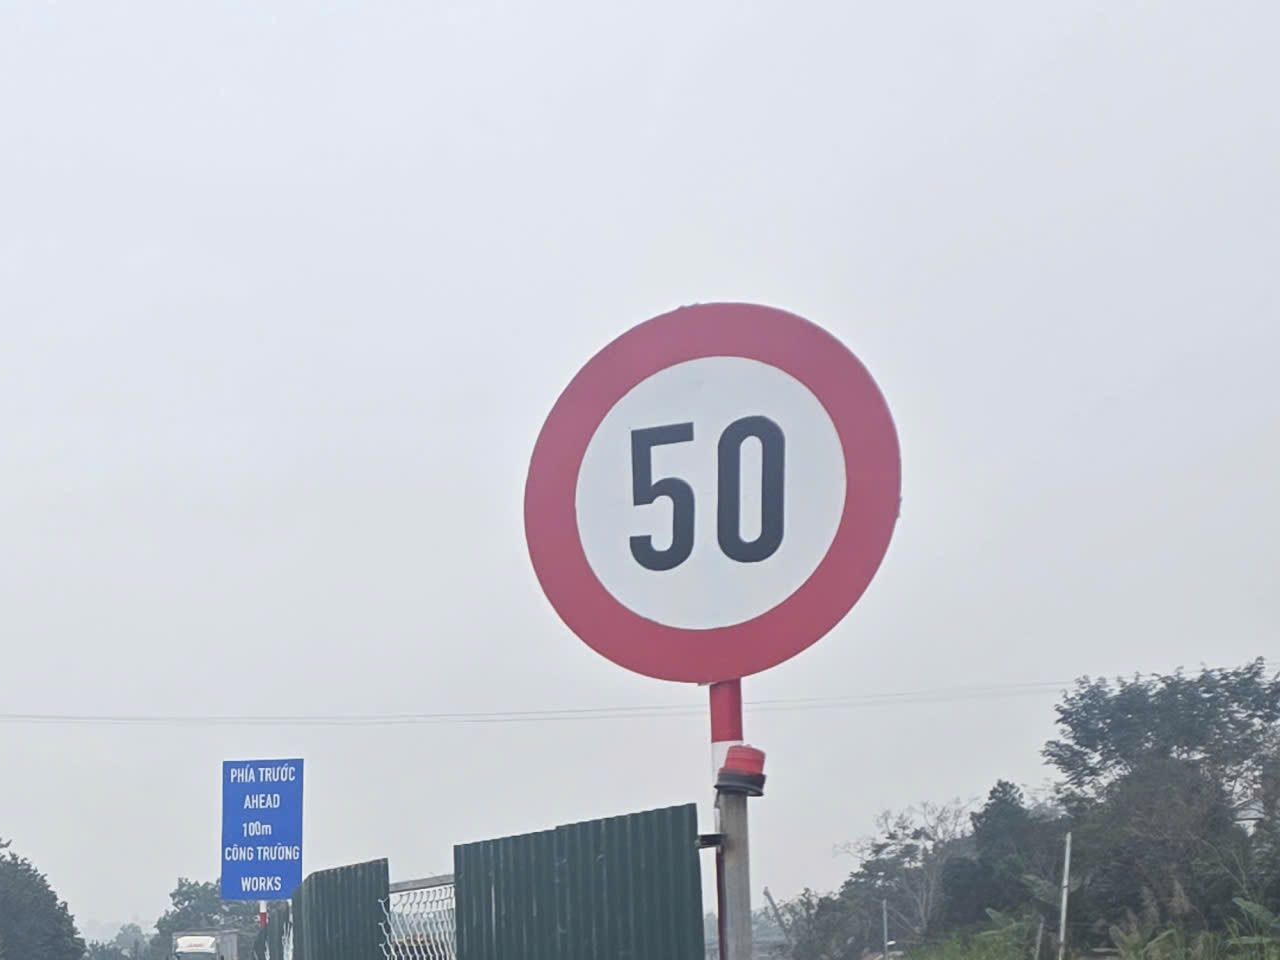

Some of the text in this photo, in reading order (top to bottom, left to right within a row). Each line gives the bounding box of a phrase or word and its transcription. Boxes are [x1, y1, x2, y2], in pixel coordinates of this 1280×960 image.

[629, 415, 786, 572] 50
[230, 763, 296, 783] PHÍA TRƯỚC
[243, 794, 280, 809] AHEAD
[242, 821, 272, 838] 100m
[224, 843, 300, 861] CÔNG TRƯỜNG
[241, 876, 282, 892] WORKS
